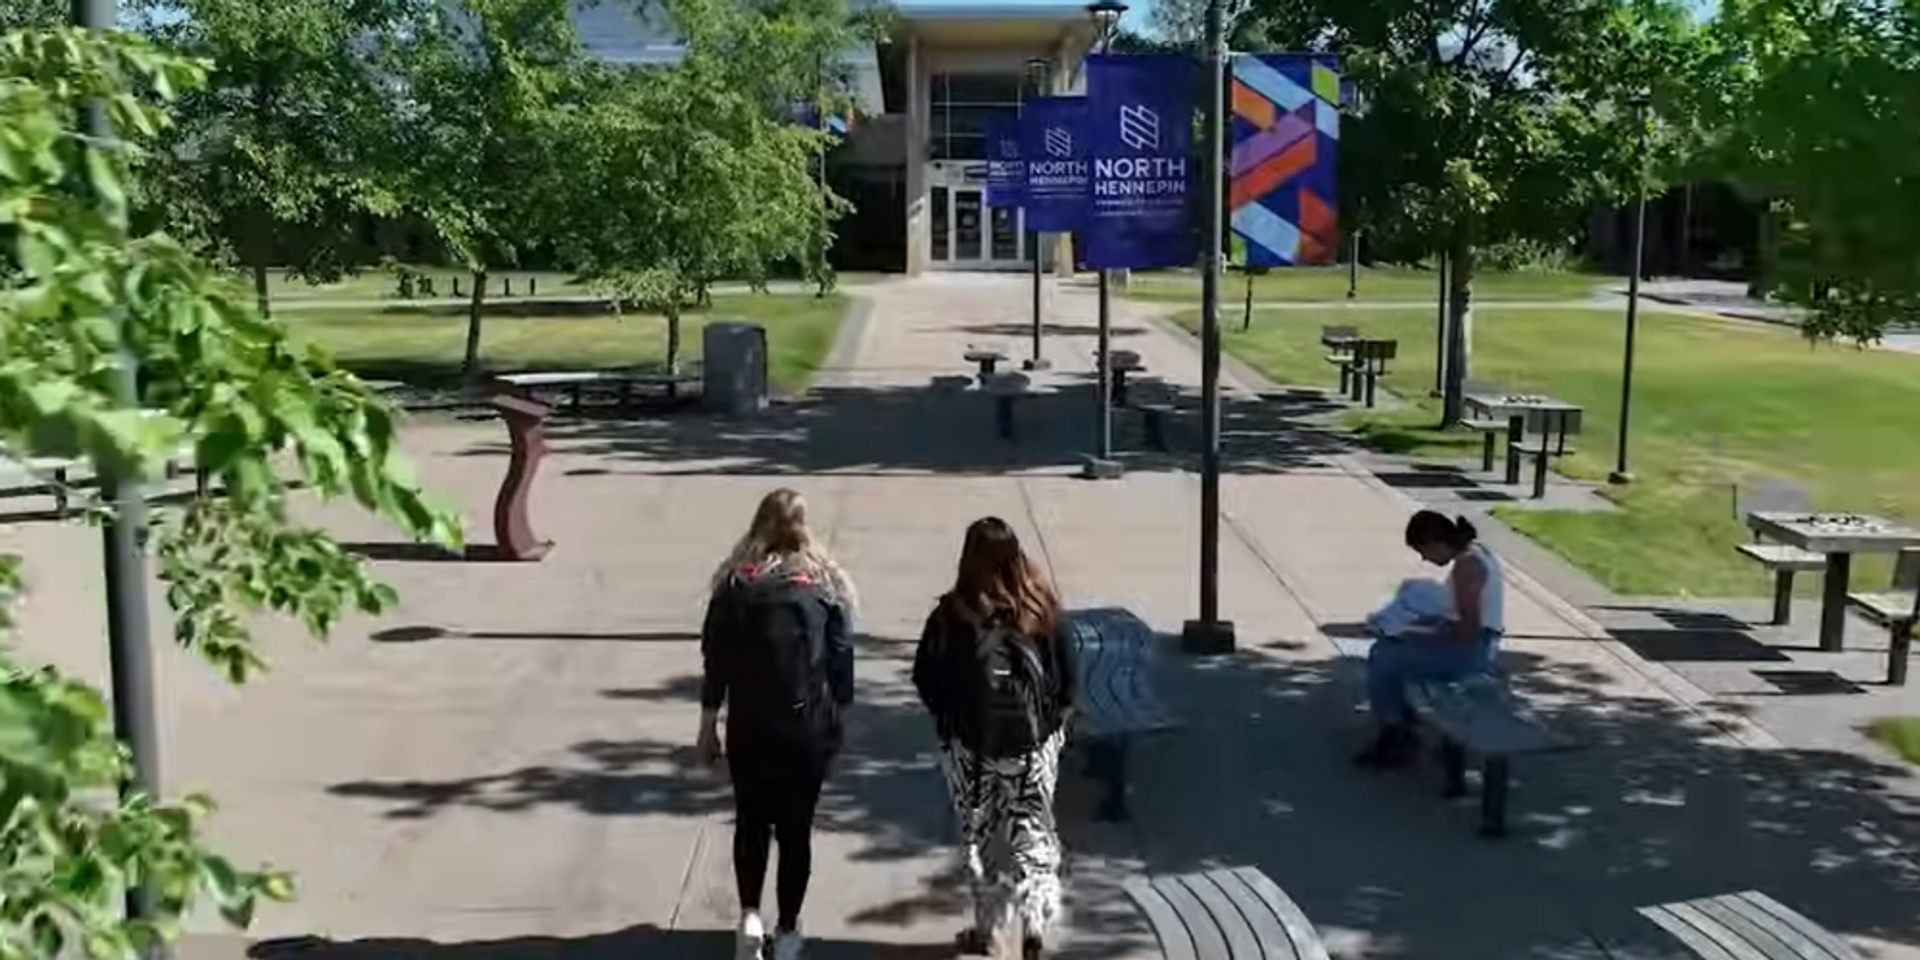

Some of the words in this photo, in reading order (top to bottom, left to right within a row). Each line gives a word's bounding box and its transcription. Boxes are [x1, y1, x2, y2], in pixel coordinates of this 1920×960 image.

[1029, 161, 1088, 174] NORTH
[1095, 158, 1186, 178] NORTH
[1095, 180, 1185, 195] HENNEPIN
